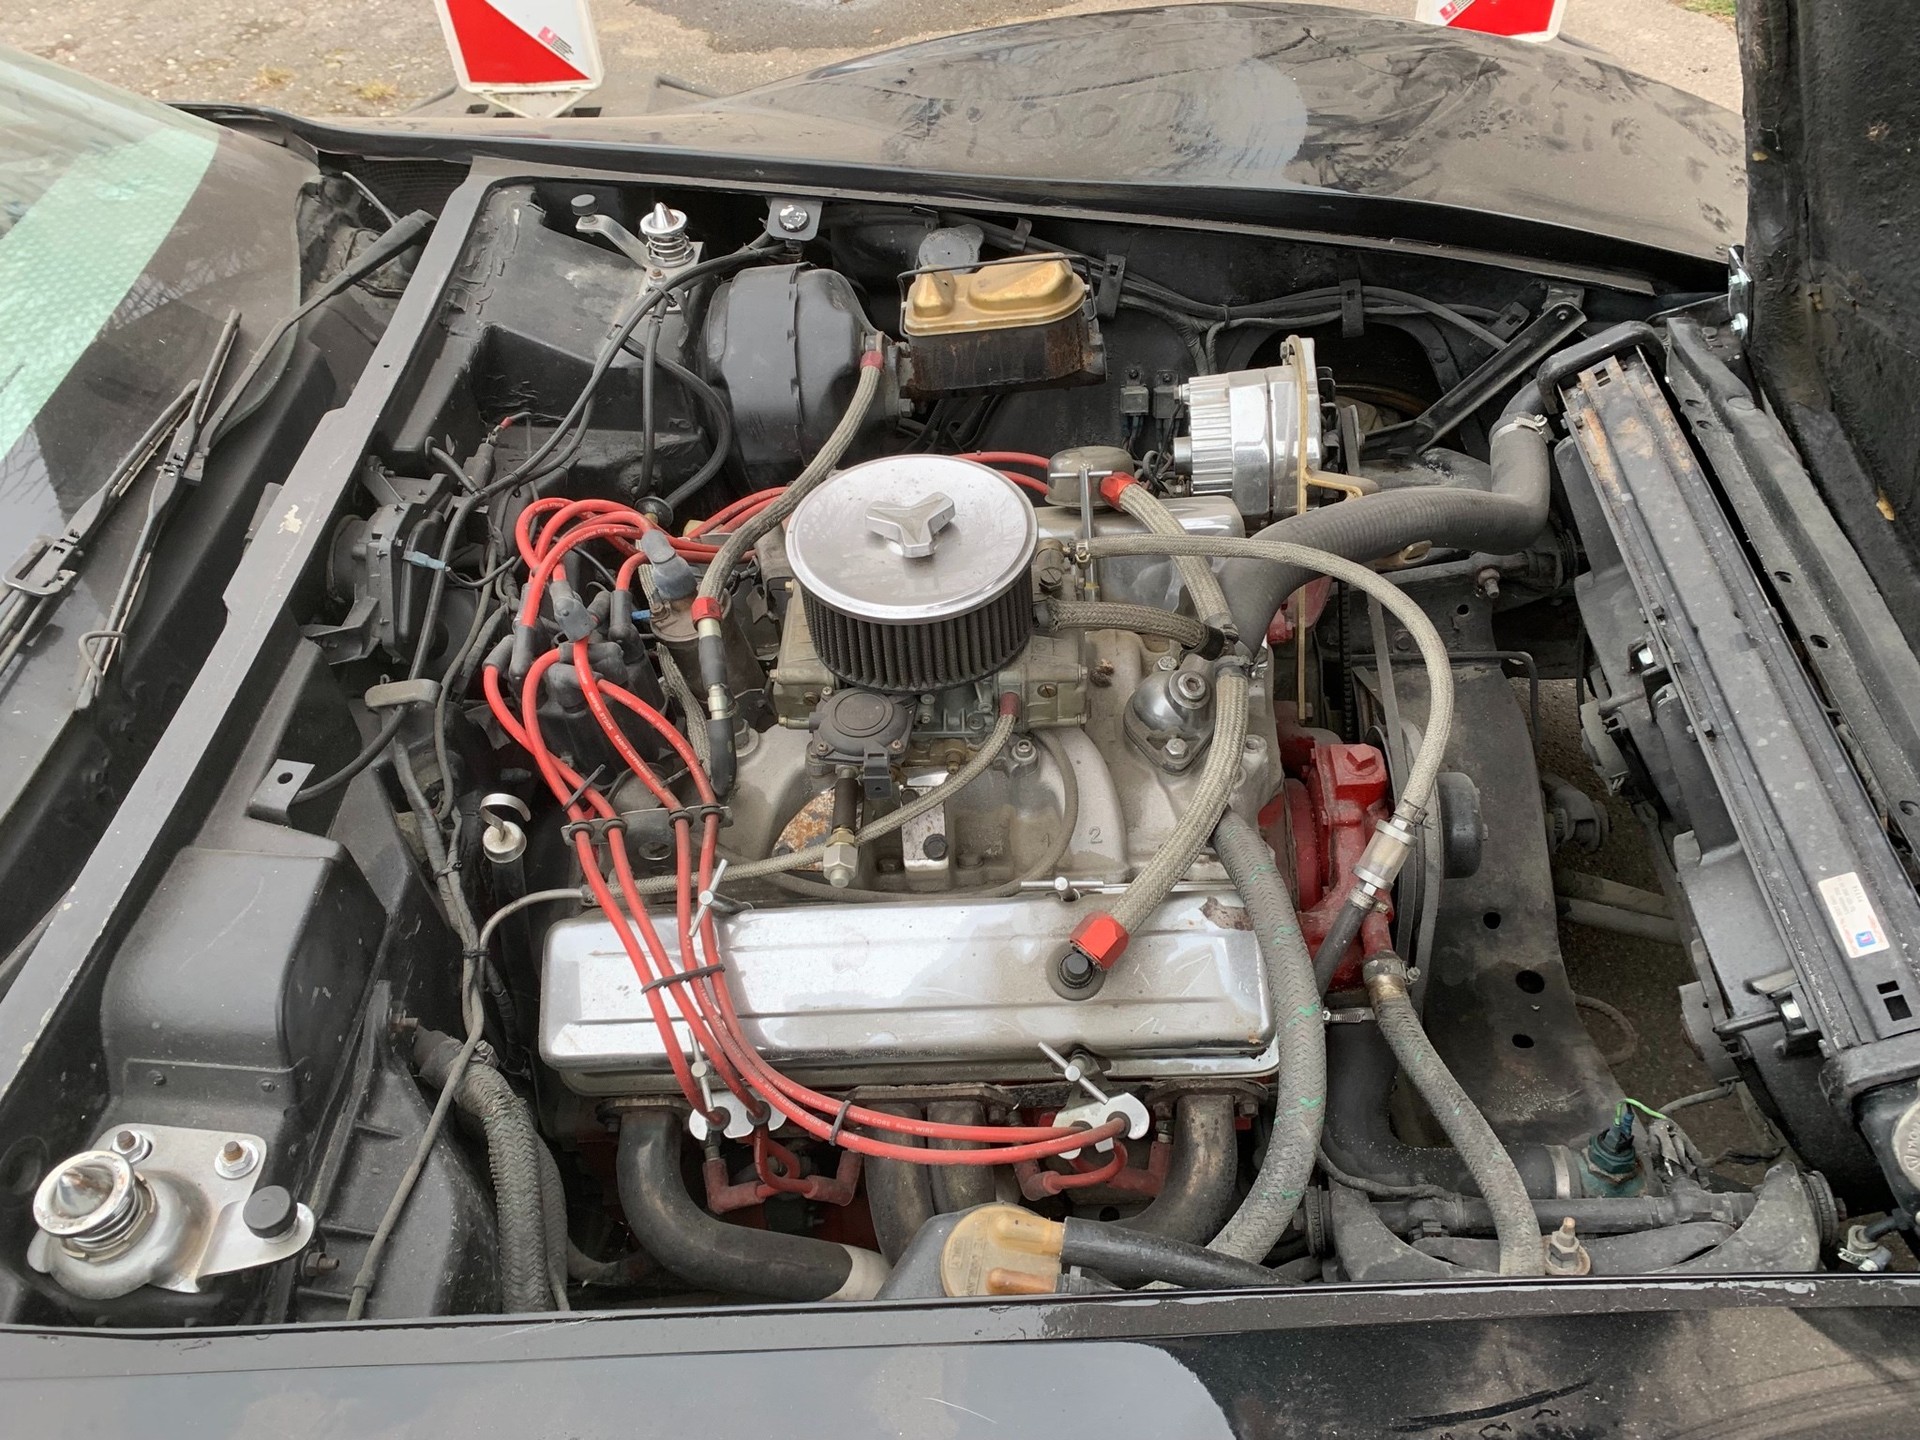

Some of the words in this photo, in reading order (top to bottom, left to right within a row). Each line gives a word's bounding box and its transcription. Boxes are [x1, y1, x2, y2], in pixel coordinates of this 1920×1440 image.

[587, 691, 602, 710] SUPER
[600, 712, 614, 730] STOCK
[614, 734, 628, 750] RADIO
[655, 721, 673, 738] STOCK
[1088, 825, 1103, 844] 2
[764, 1083, 803, 1117] SUPPRESSION
[805, 1114, 822, 1127] CORE
[842, 1132, 859, 1141] WIRE
[774, 1079, 794, 1094] STOCK
[801, 1094, 822, 1107] RADIO
[872, 1118, 891, 1127] CORE
[915, 1126, 935, 1134] WIRE
